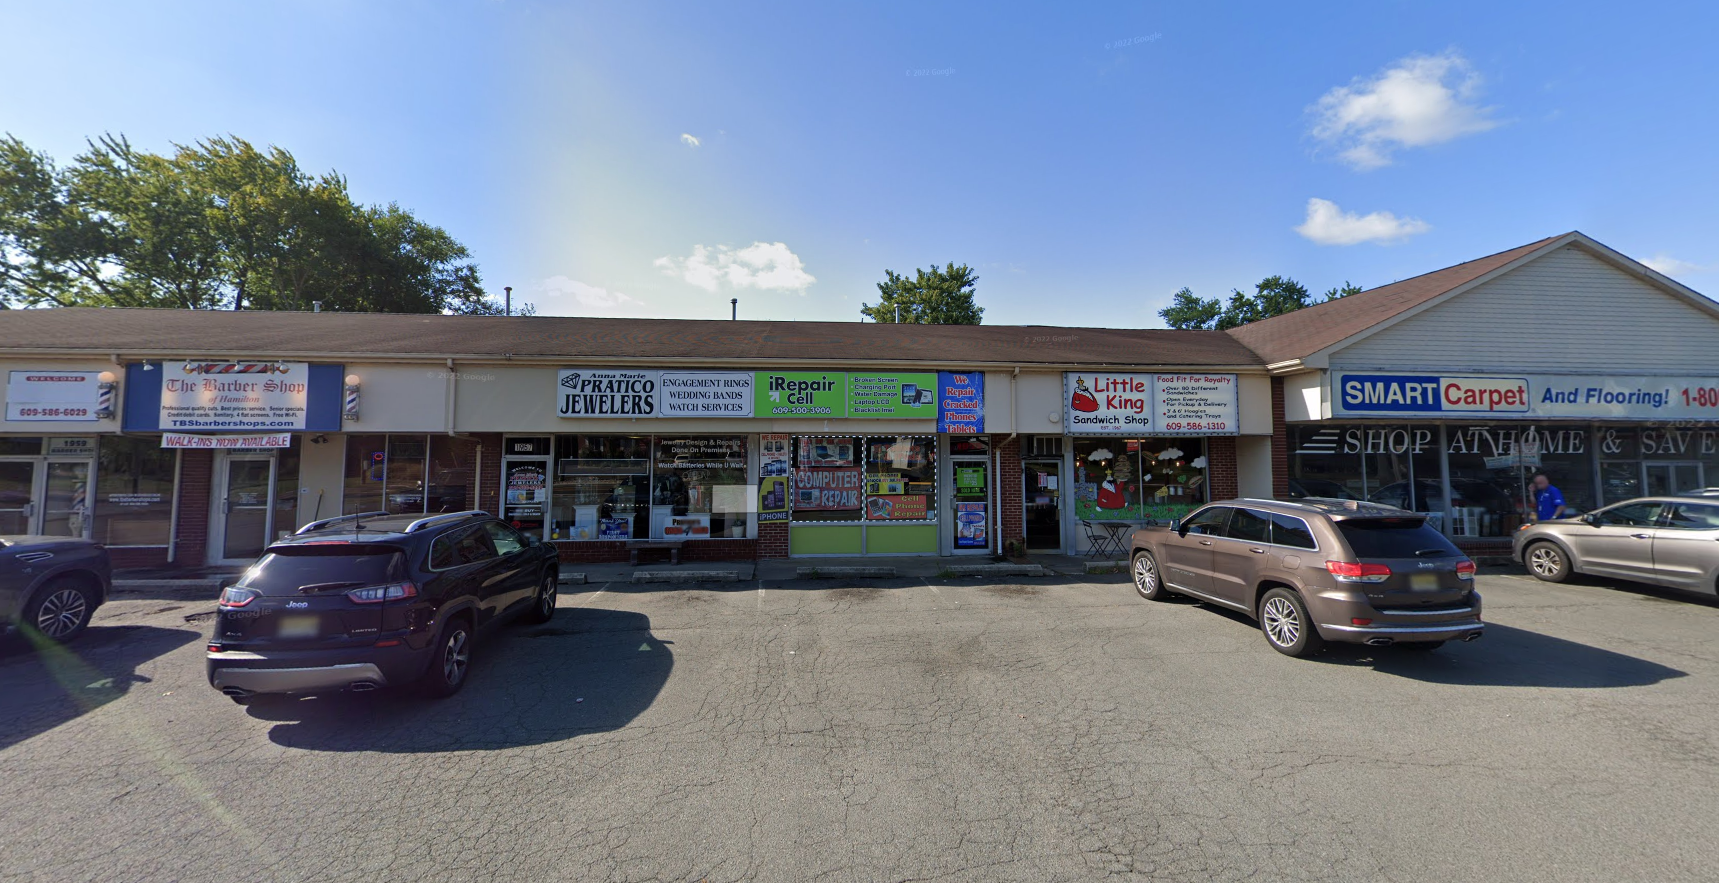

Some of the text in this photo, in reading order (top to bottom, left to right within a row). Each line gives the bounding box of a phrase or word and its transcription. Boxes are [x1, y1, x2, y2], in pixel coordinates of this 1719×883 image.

[663, 379, 750, 388] ENGAGEMENT RINGS
[954, 375, 968, 384] We
[1094, 377, 1146, 393] Little
[166, 378, 305, 394] The Barber Shop
[580, 380, 654, 393] PRATICO
[769, 376, 835, 395] iRepair
[670, 391, 743, 400] WEDDING BANDS
[946, 387, 975, 398] Repair
[1345, 381, 1719, 410] SMART Carpet And Flooring! 1-80
[208, 396, 260, 404] of Hamilton
[560, 394, 654, 414] JEWELERS
[787, 392, 814, 405] Cell
[669, 403, 743, 411] WATCH SERVICES
[943, 400, 978, 409] Cracked
[1106, 395, 1144, 414] King
[20, 408, 87, 416] 609-586-6029
[945, 412, 977, 421] Phones
[1073, 416, 1149, 426] Sandwich Shop
[945, 424, 976, 433] Tablets
[166, 436, 288, 447] WALK-INS NOW AVAILABLE
[1344, 429, 1716, 454] SHOP AT HOME & SAVE
[798, 471, 859, 488] COMPUTER
[821, 491, 858, 506] REPAIR
[760, 512, 786, 520] iPHONE
[286, 600, 308, 609] Jeep
